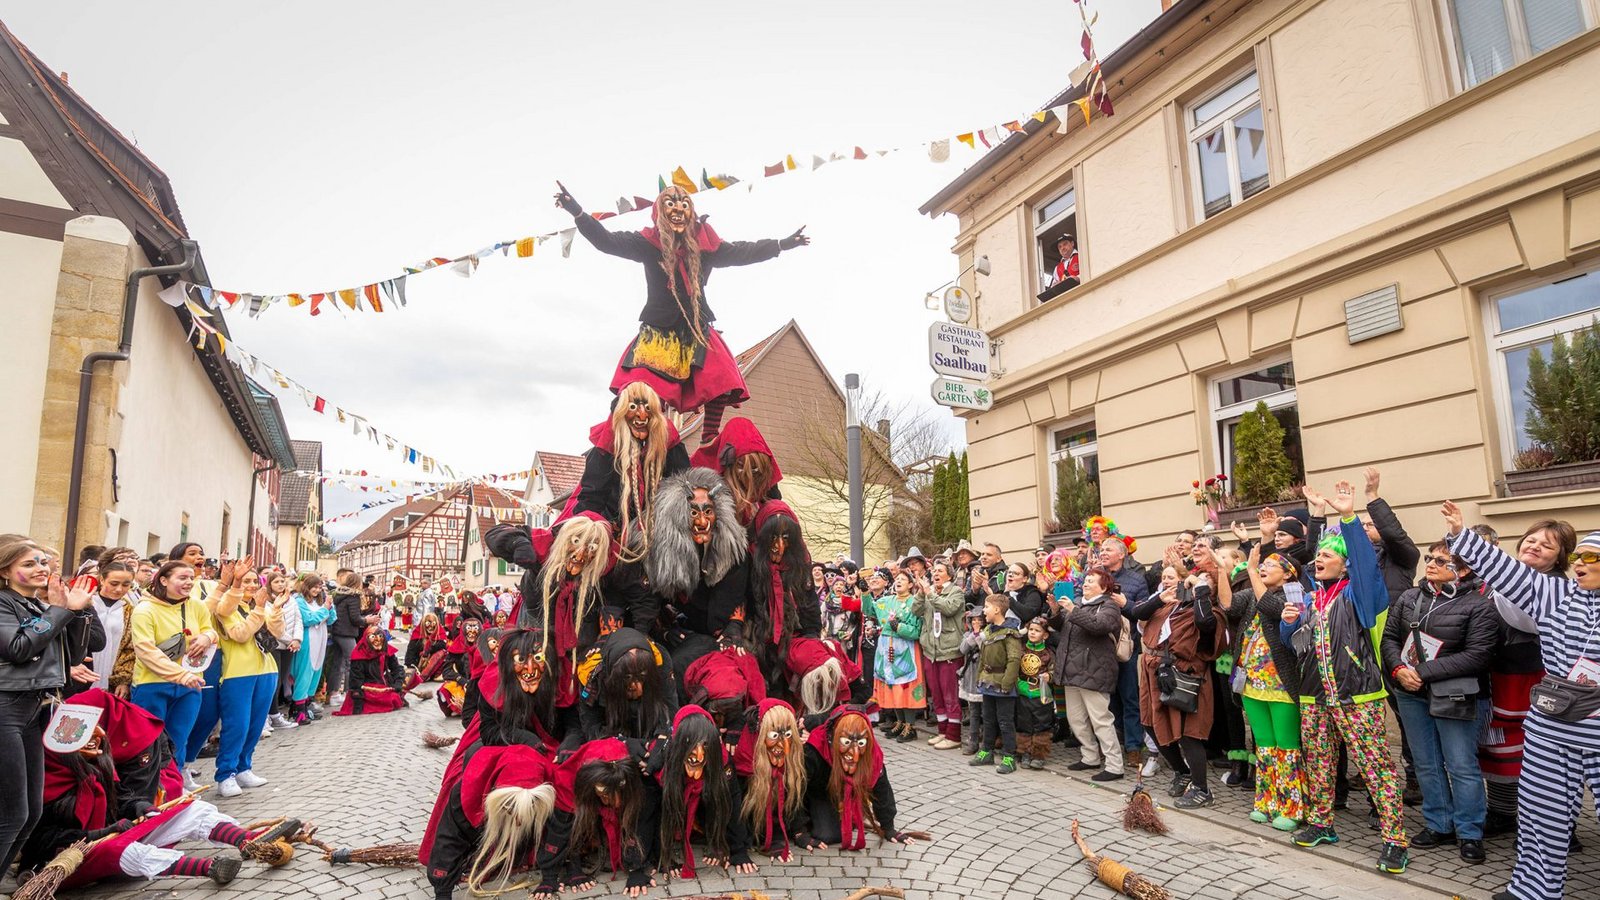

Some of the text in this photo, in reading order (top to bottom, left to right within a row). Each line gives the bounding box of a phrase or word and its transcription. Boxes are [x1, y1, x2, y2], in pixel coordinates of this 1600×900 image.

[941, 324, 981, 339] GASTHAUS
[938, 333, 984, 348] RESTAURANT
[952, 344, 970, 356] Der
[934, 352, 987, 373] Saalbau
[945, 382, 967, 394] BIER-
[938, 391, 973, 404] GARTEN
